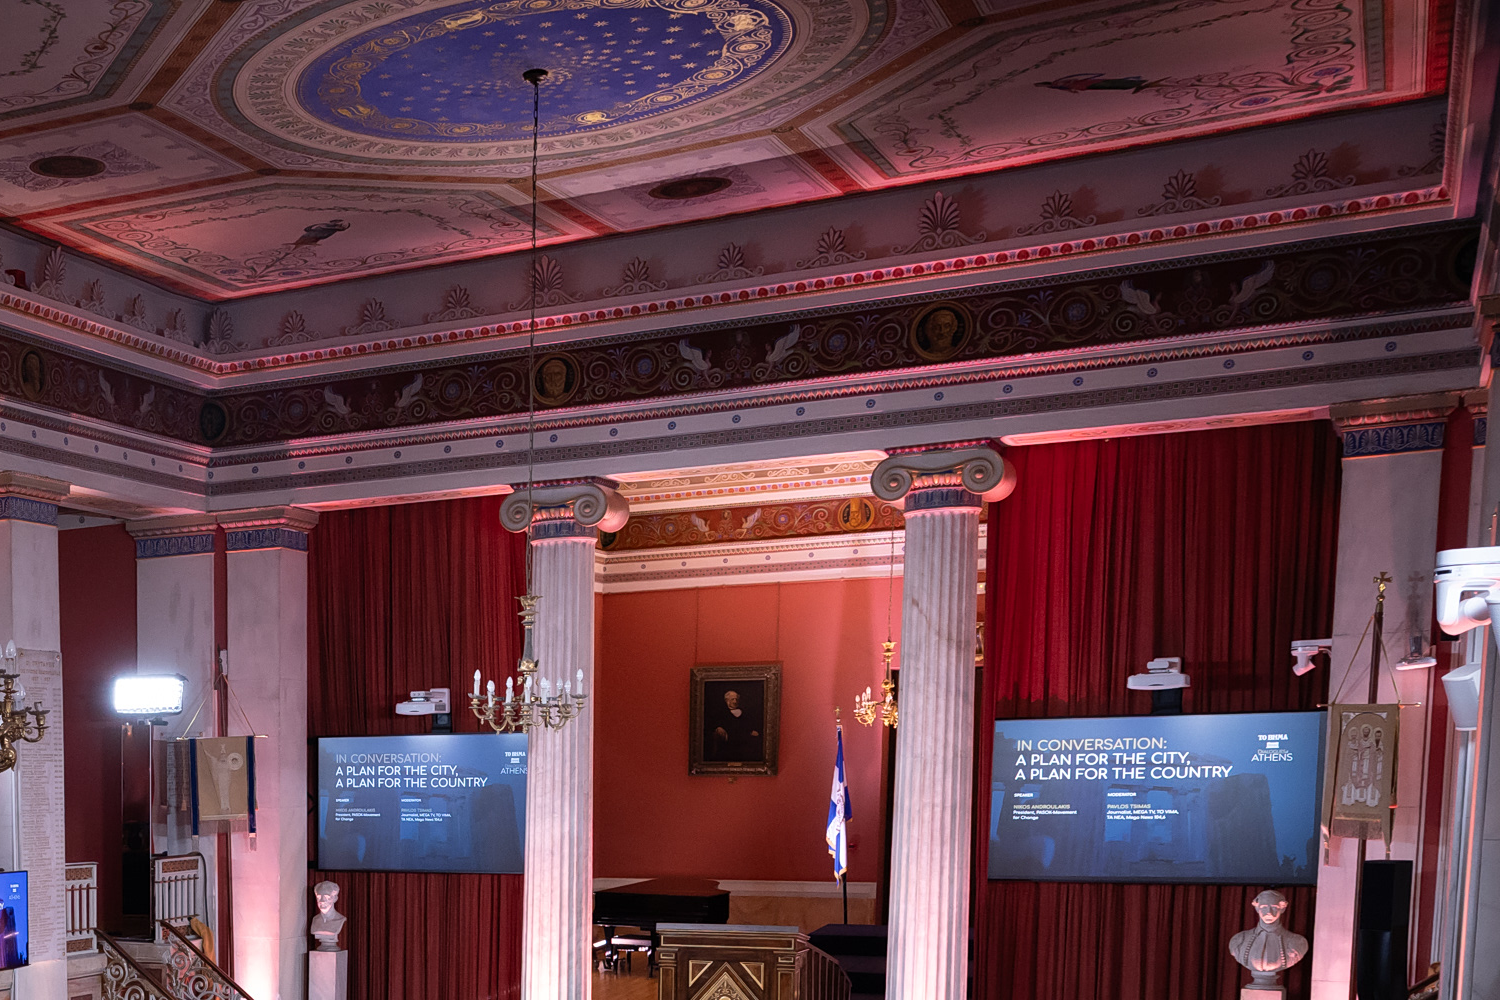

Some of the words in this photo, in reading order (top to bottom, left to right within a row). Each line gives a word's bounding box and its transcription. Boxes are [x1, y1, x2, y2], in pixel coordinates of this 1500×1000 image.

[1017, 740, 1031, 752] IN
[1038, 737, 1167, 751] CONVERSATION:
[336, 754, 347, 763] IN
[351, 753, 441, 763] CONVERSATION:
[1015, 754, 1026, 766] A
[1030, 754, 1071, 766] PLAN
[1076, 753, 1109, 765] FOR
[1112, 753, 1146, 765] THE
[1151, 752, 1190, 766] CITY,
[1251, 753, 1293, 762] ATHENS
[335, 766, 344, 776] A
[347, 766, 375, 776] PLAN
[378, 766, 401, 776] FOR
[404, 766, 427, 775] THE
[430, 765, 459, 777] CITY,
[1015, 768, 1026, 780] A
[1030, 768, 1071, 780] PLAN
[1075, 768, 1108, 780] FOR
[1112, 767, 1146, 779] THE
[1150, 766, 1233, 779] COUNTRY
[335, 778, 344, 788] A
[347, 778, 375, 788] PLAN
[378, 778, 401, 788] FOR
[404, 778, 427, 787] THE
[430, 777, 488, 787] COUNTRY
